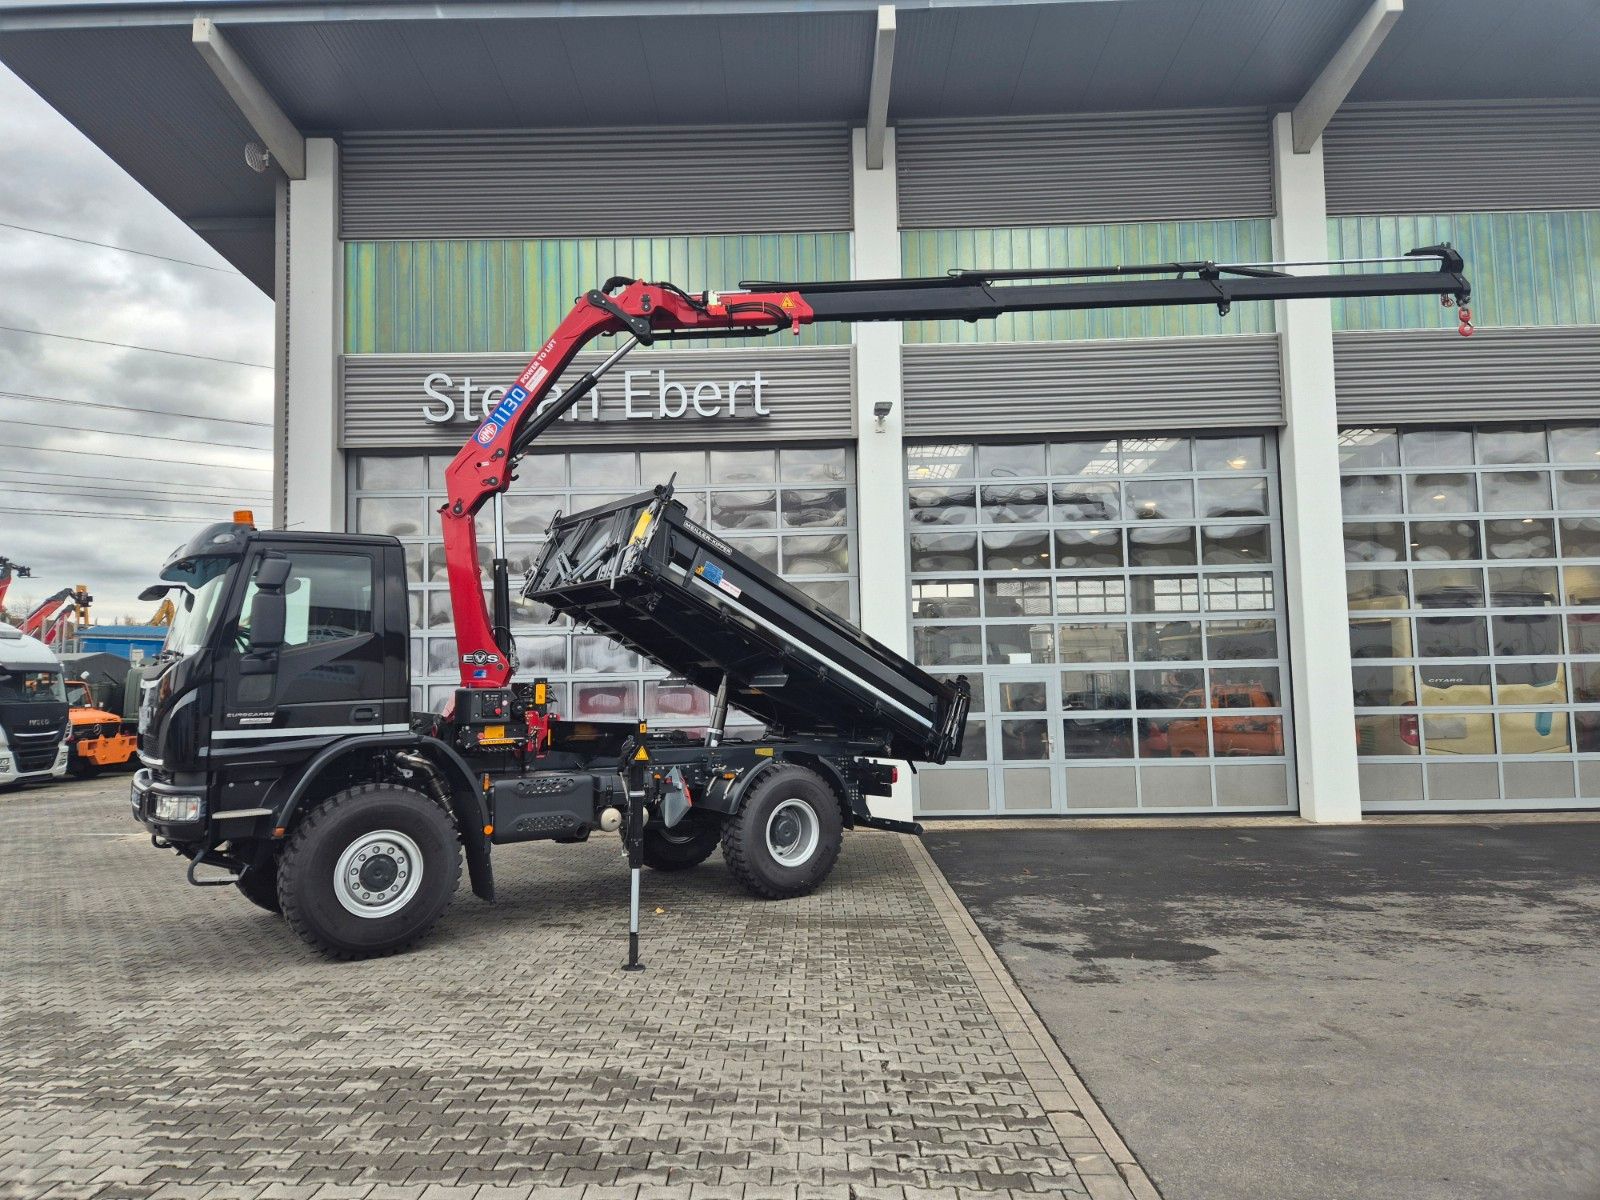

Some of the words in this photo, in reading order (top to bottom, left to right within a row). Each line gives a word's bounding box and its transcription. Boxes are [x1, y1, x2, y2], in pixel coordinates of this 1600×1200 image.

[520, 361, 540, 384] POWER
[537, 351, 547, 362] TO
[544, 338, 557, 353] LIFT
[422, 372, 599, 423] Stean
[624, 369, 771, 418] Ebert
[479, 423, 496, 443] HMF
[494, 387, 526, 423] 1130
